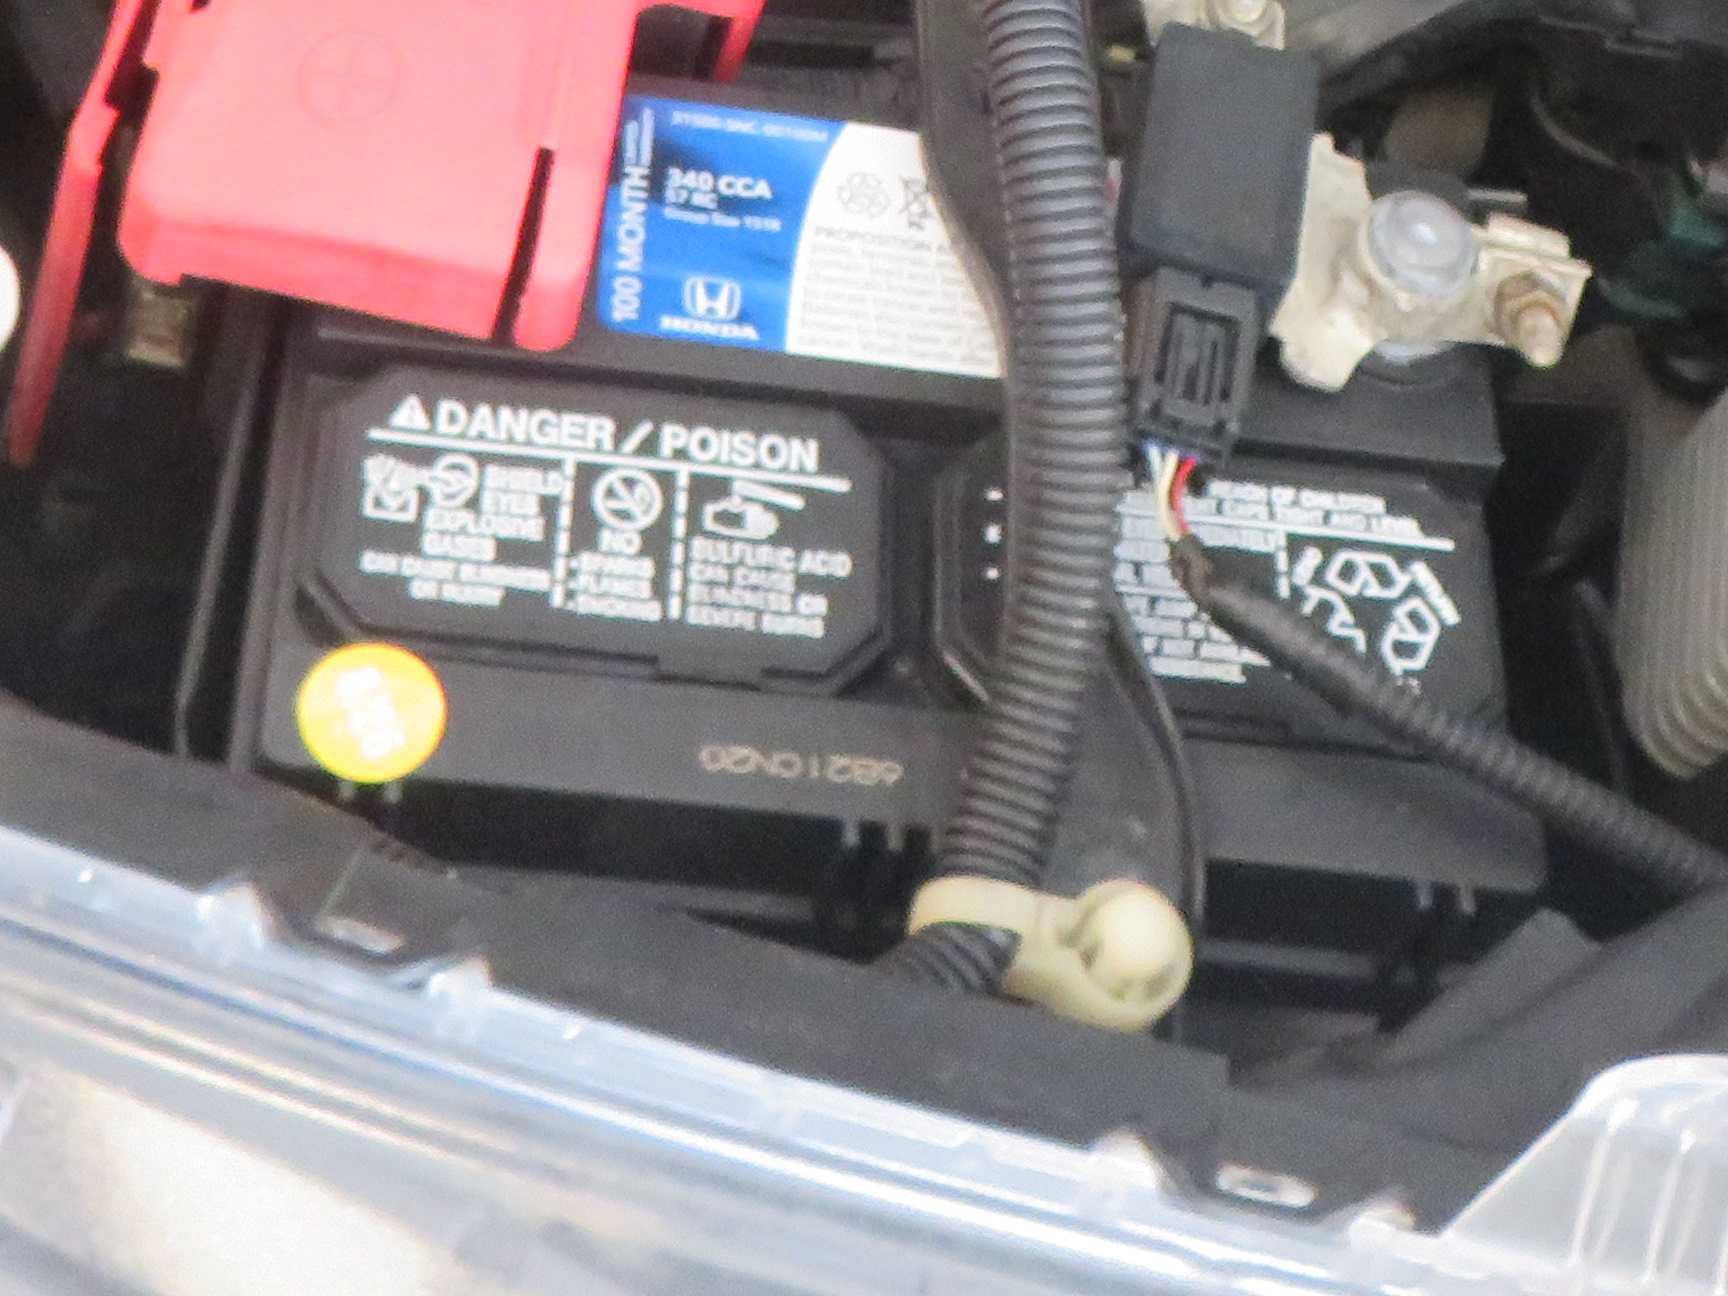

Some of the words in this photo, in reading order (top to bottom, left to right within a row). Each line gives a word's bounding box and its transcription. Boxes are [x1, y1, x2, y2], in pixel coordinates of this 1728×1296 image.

[717, 173, 772, 200] CCA
[617, 165, 650, 272] MONTH
[611, 276, 644, 322] 100
[660, 315, 761, 341] HONDA
[434, 399, 616, 449] DANGER
[659, 427, 820, 473] POISON
[598, 528, 642, 555] NO
[799, 549, 852, 578] ACID
